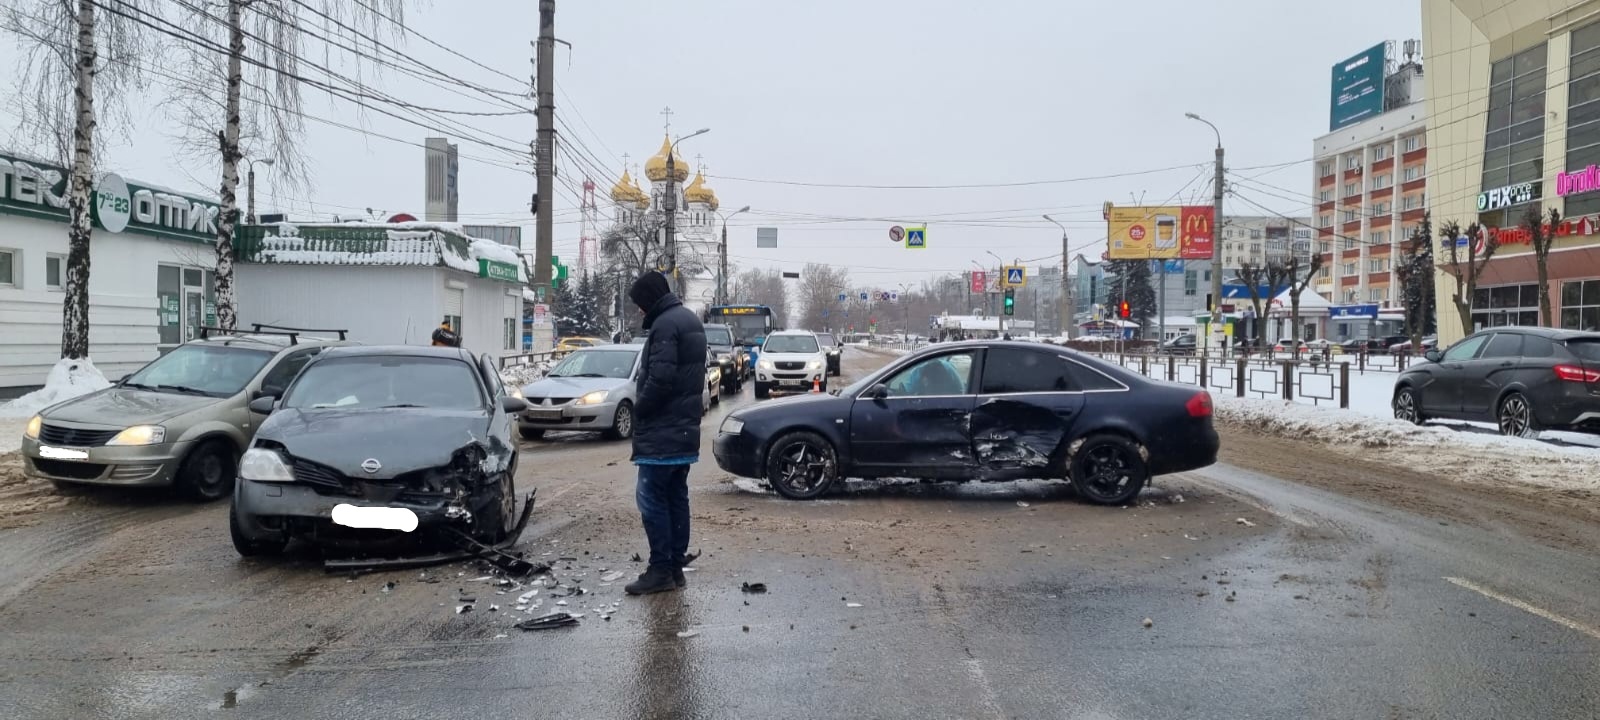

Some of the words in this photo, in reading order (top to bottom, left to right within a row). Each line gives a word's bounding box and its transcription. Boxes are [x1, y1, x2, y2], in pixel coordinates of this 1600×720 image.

[132, 189, 221, 235] ОПТИК
[1488, 185, 1512, 210] FIX
[1510, 183, 1532, 198] price
